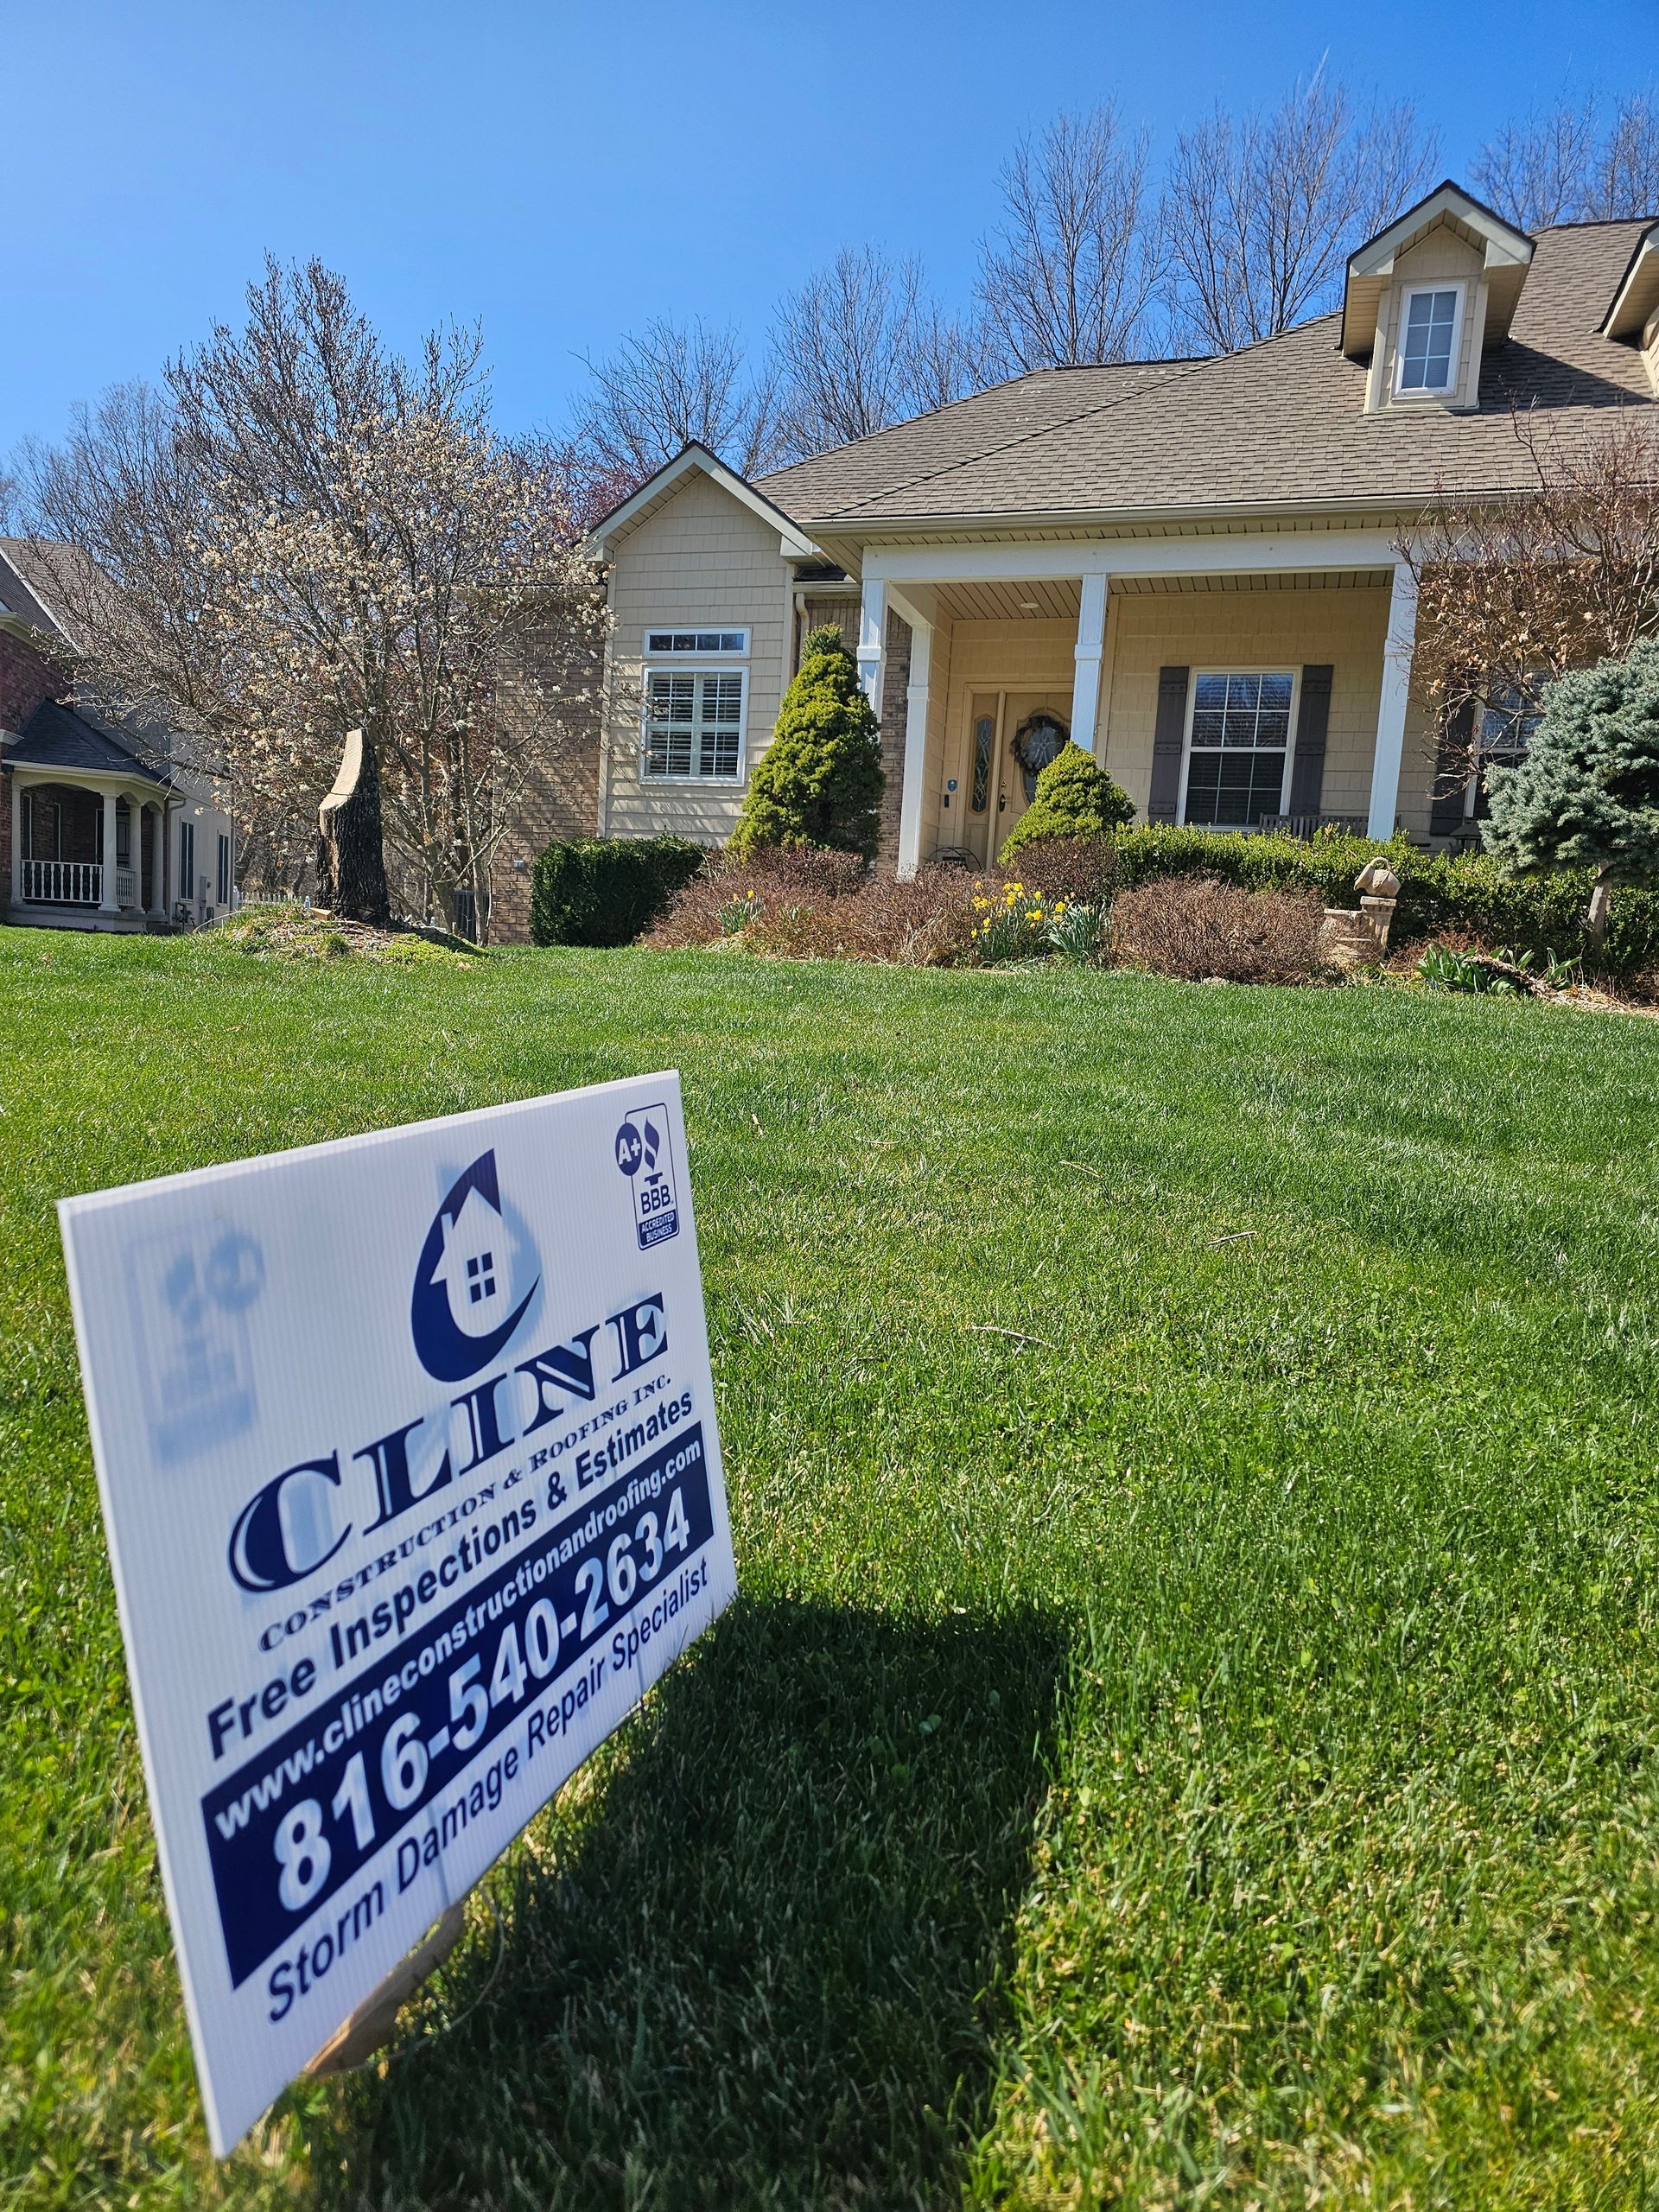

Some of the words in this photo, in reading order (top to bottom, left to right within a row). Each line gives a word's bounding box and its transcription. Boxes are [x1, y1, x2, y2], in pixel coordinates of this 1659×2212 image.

[618, 1138, 641, 1165] A+
[640, 1185, 671, 1215] BBB
[641, 1212, 675, 1233] ACCREDITED
[645, 1223, 672, 1243] BUSINESS
[207, 1656, 317, 1762] Free
[330, 1499, 537, 1670] Inspections
[547, 1471, 568, 1510] &
[575, 1392, 692, 1491] Estimates
[228, 1291, 669, 1592] CLINE
[257, 1483, 497, 1652] CONSTRUCTION
[503, 1467, 524, 1490] &
[528, 1399, 628, 1474] ROOFING
[632, 1374, 671, 1407] INC.
[214, 1440, 702, 1840] www.clineconstructionandroofing.com
[272, 1485, 690, 1914] 816-540-2634
[267, 1879, 385, 2024] Storm
[397, 1743, 520, 1894] Damage
[527, 1659, 606, 1759] Repair
[610, 1554, 709, 1673] Specialist
